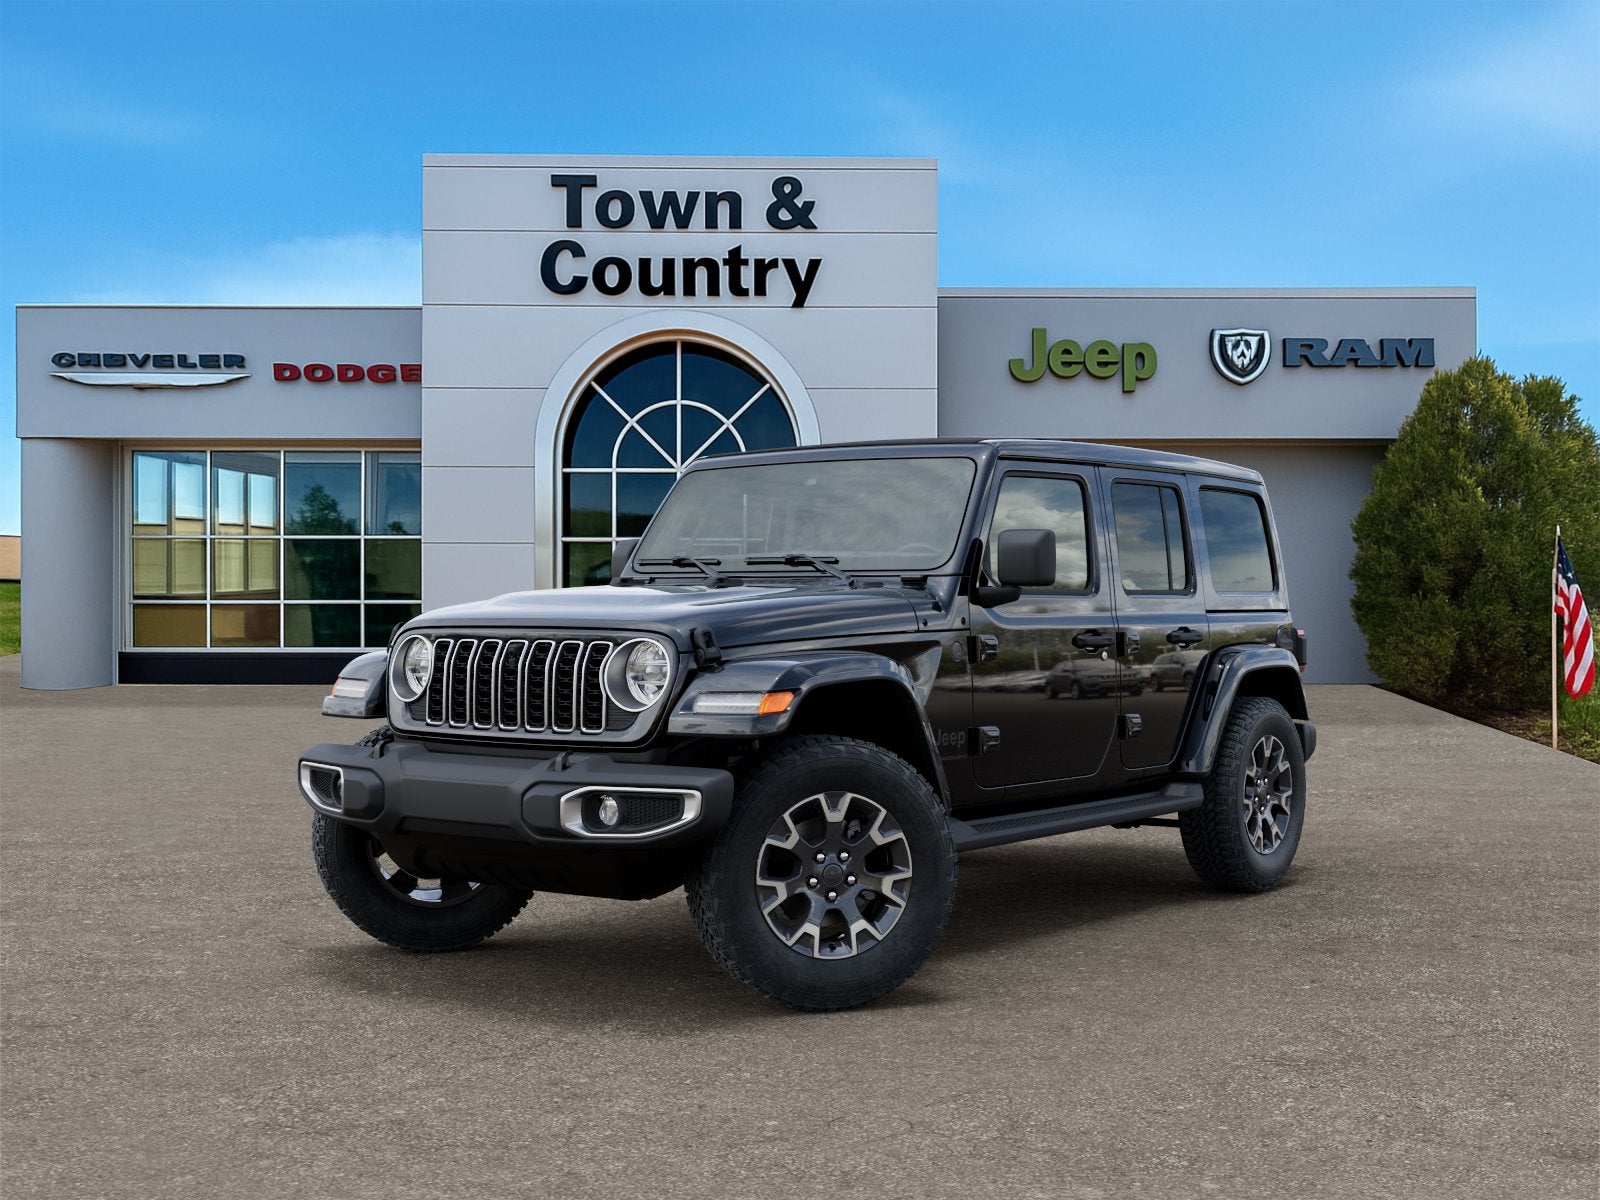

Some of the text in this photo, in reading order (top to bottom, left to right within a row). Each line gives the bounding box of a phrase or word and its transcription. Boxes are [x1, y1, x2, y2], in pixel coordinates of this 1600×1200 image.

[550, 173, 818, 230] Town &
[540, 239, 822, 308] Country
[272, 362, 422, 383] DODGE
[1008, 327, 1158, 393] Jeep
[1282, 337, 1435, 368] RAM
[936, 728, 966, 748] Jeep
